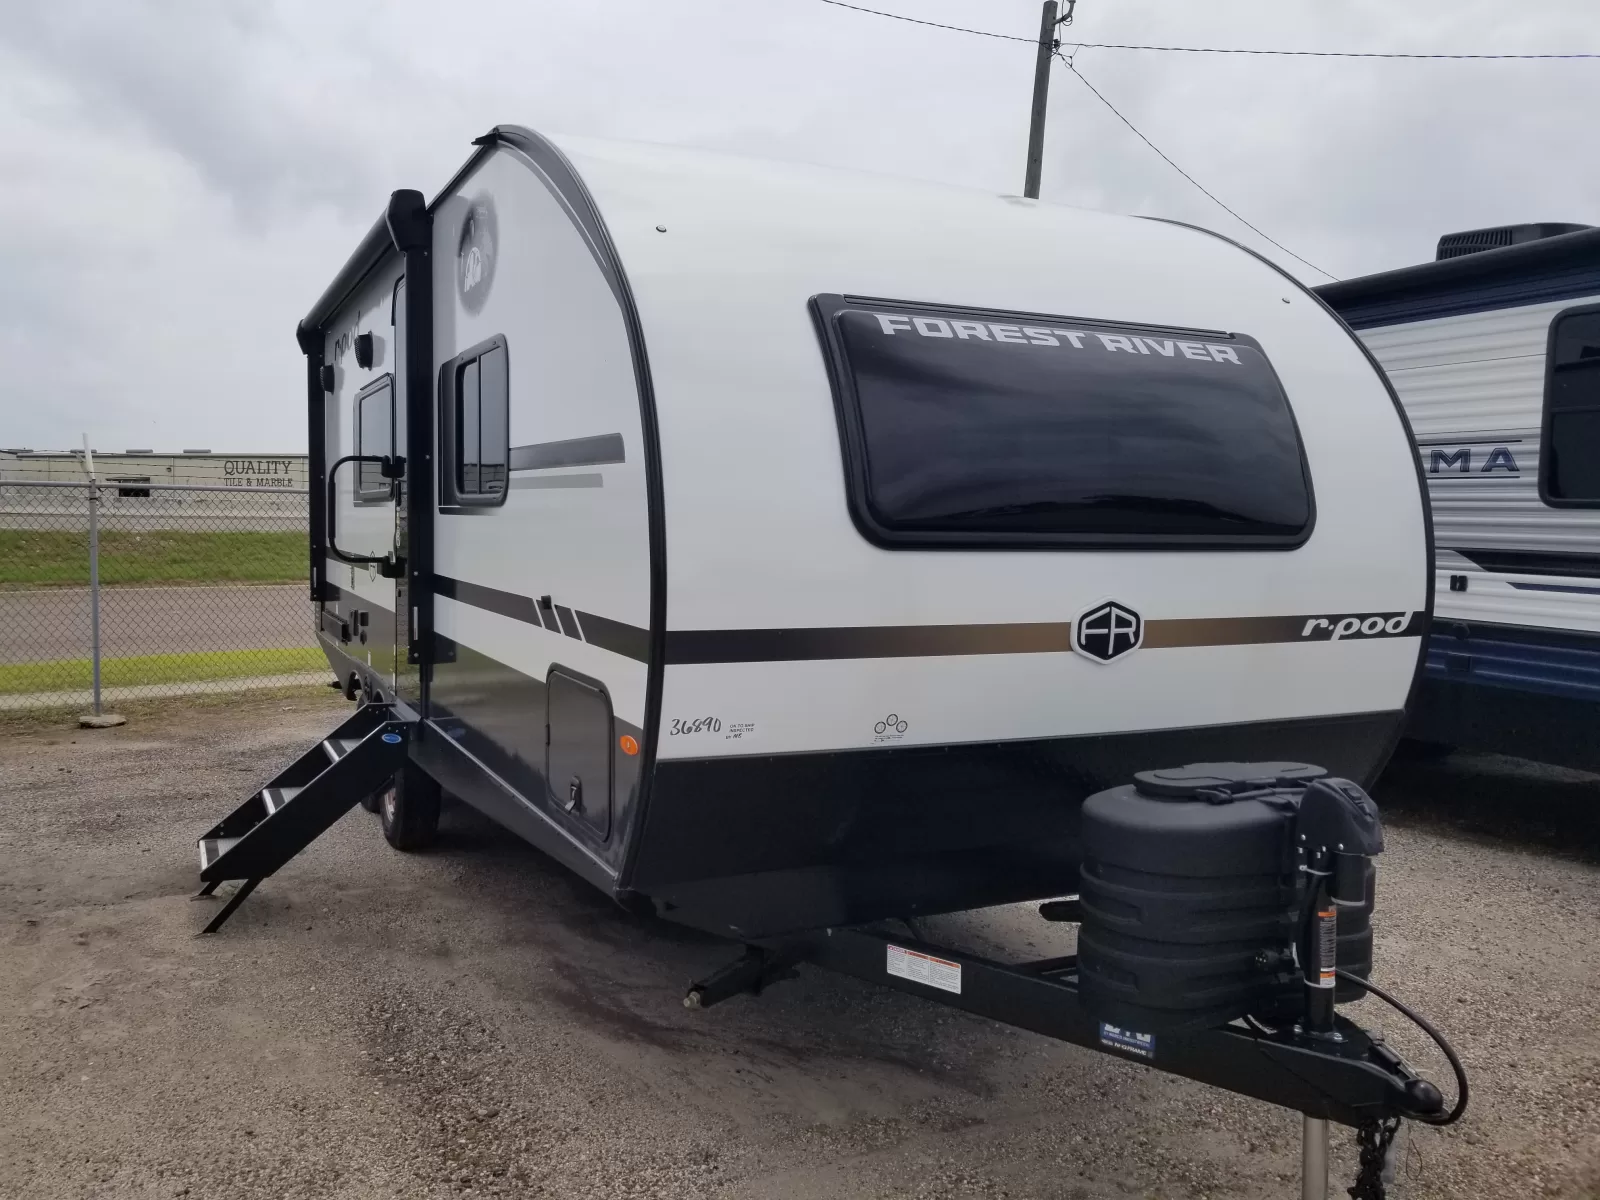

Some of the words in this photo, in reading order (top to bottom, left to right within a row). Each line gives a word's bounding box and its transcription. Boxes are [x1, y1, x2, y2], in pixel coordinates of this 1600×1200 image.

[873, 314, 1085, 349] FOREST
[1094, 333, 1242, 365] RIVER
[224, 460, 292, 476] QUALITY
[224, 477, 243, 487] TILE
[246, 477, 252, 487] &
[256, 477, 293, 488] MARBLE
[669, 716, 722, 736] 36890
